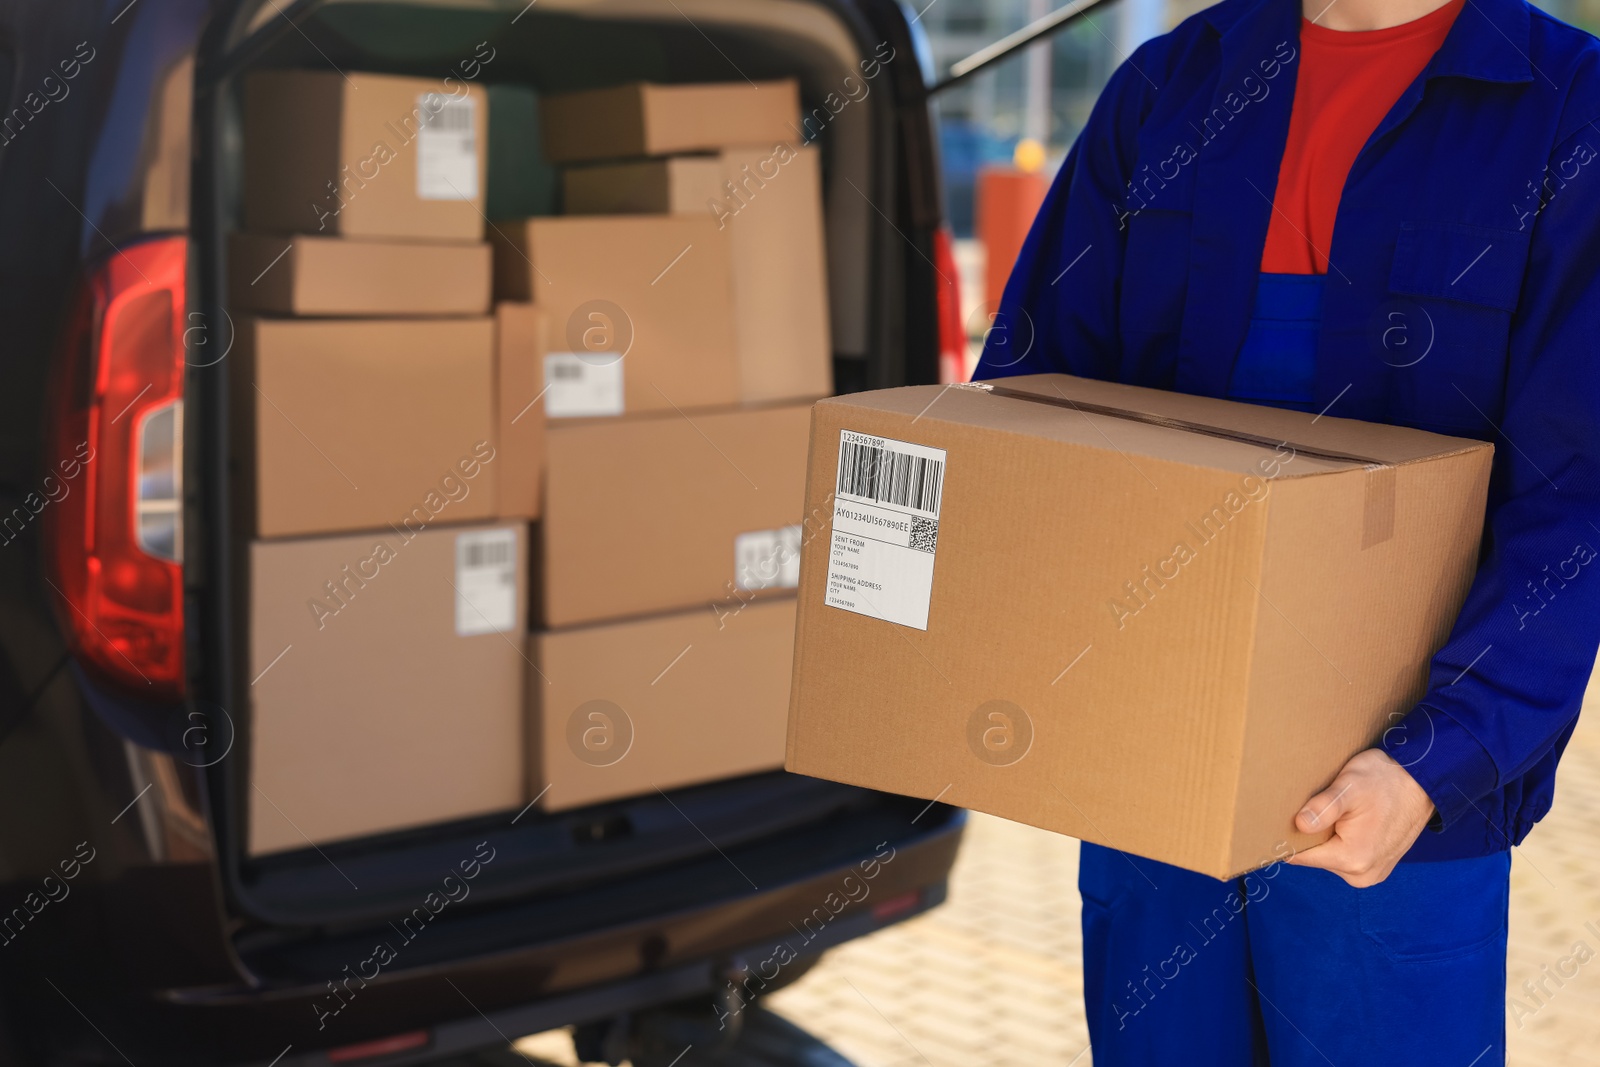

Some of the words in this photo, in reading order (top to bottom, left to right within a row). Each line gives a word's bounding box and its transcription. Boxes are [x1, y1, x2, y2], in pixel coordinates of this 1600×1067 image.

[843, 432, 885, 449] 1234567890
[836, 507, 909, 533] AY01234UI567890EE
[834, 543, 846, 551] YOUR
[847, 546, 860, 555] NAME
[835, 535, 849, 544] SENT
[849, 538, 865, 548] FROM
[830, 580, 842, 588] YOUR
[843, 584, 856, 593] NAME
[831, 572, 857, 585] SHIPPING
[857, 579, 882, 592] ADDRESS
